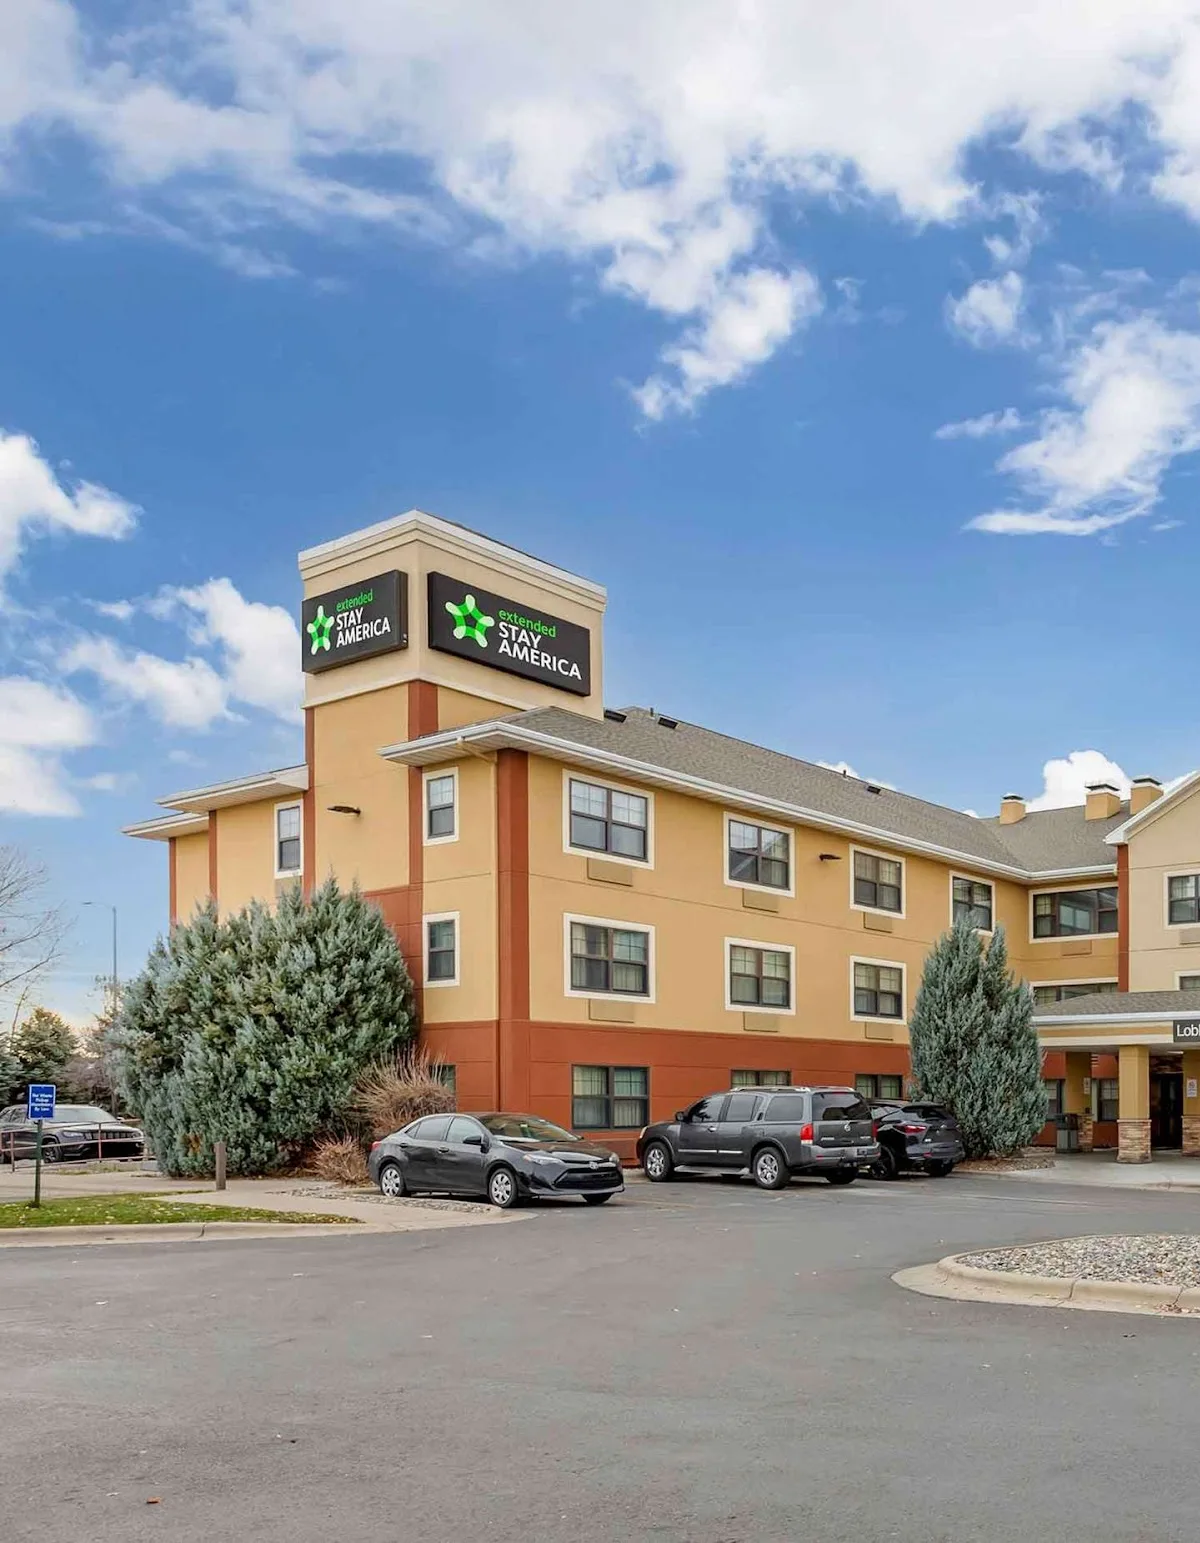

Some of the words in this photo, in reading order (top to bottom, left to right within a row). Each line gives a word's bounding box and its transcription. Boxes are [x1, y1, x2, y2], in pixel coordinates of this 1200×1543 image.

[336, 588, 373, 612] extended
[336, 607, 364, 631] STAY
[336, 616, 391, 648] AMERICA
[498, 610, 556, 637] extended
[498, 621, 542, 649] STAY
[498, 639, 582, 680] AMERICA
